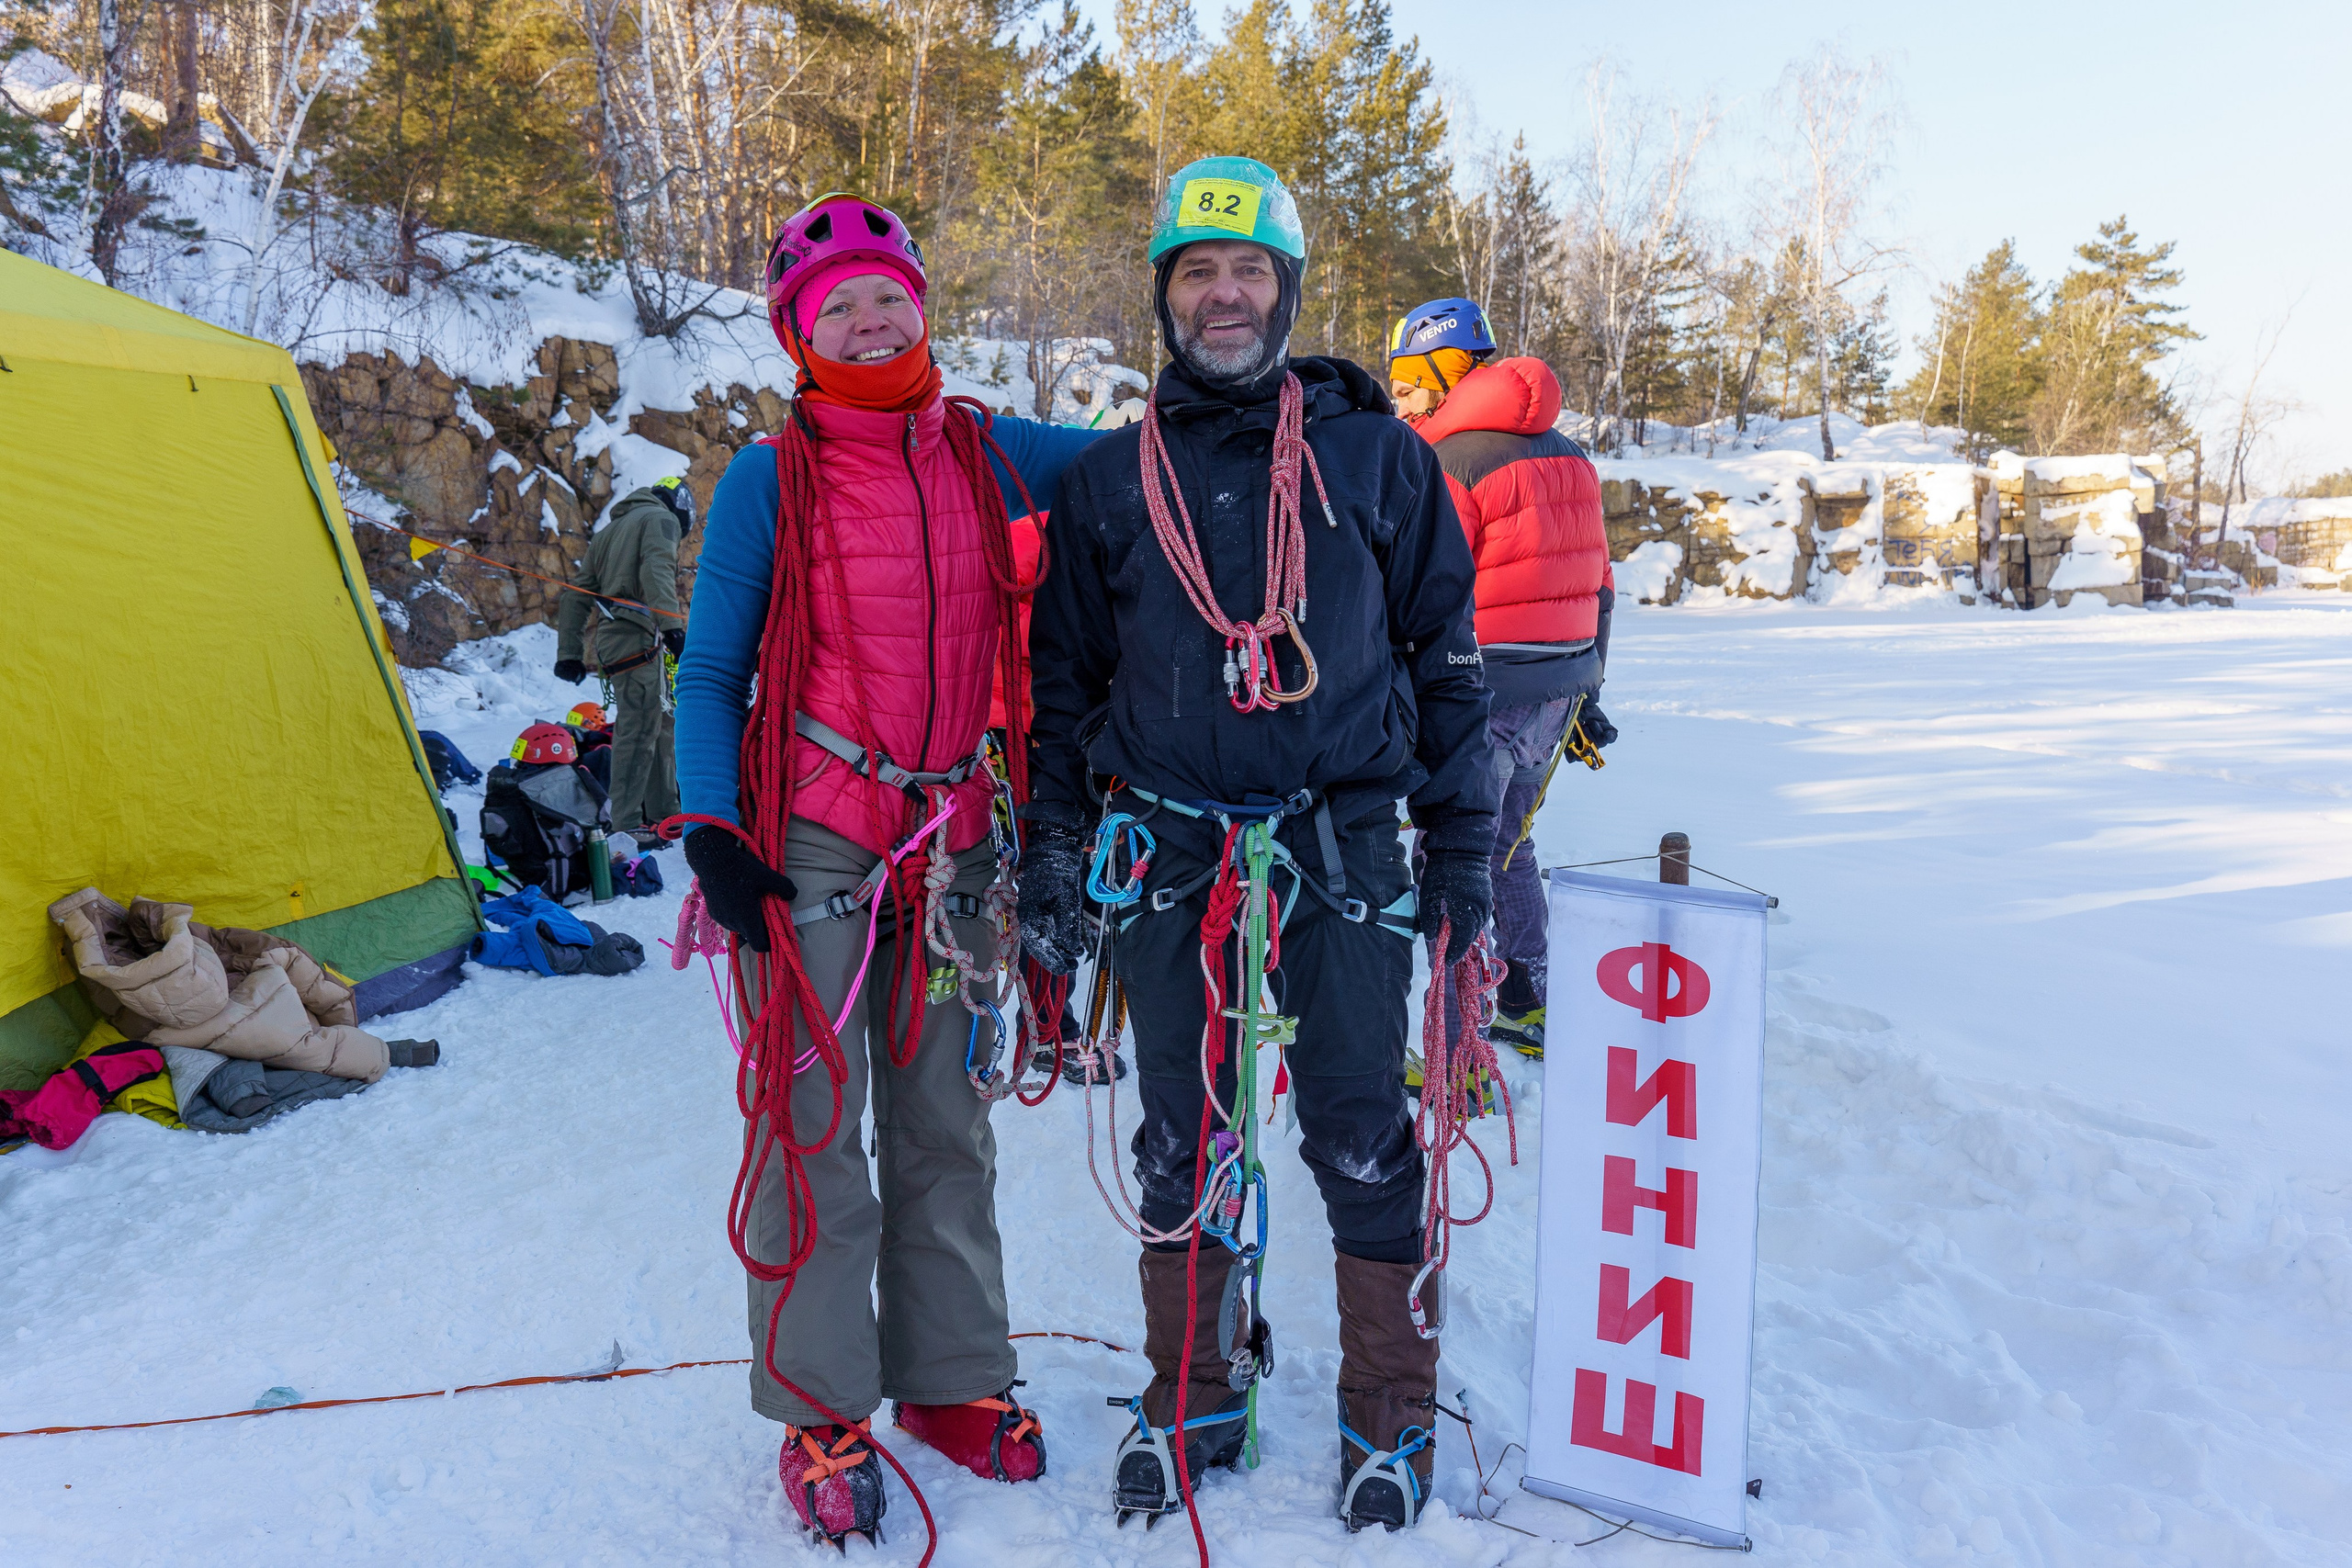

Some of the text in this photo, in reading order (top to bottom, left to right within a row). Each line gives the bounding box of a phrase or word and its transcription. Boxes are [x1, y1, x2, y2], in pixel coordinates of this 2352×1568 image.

[1198, 191, 1241, 217] 8.2
[1419, 318, 1457, 343] VENTO
[1571, 941, 1711, 1477] ФИНИШ
